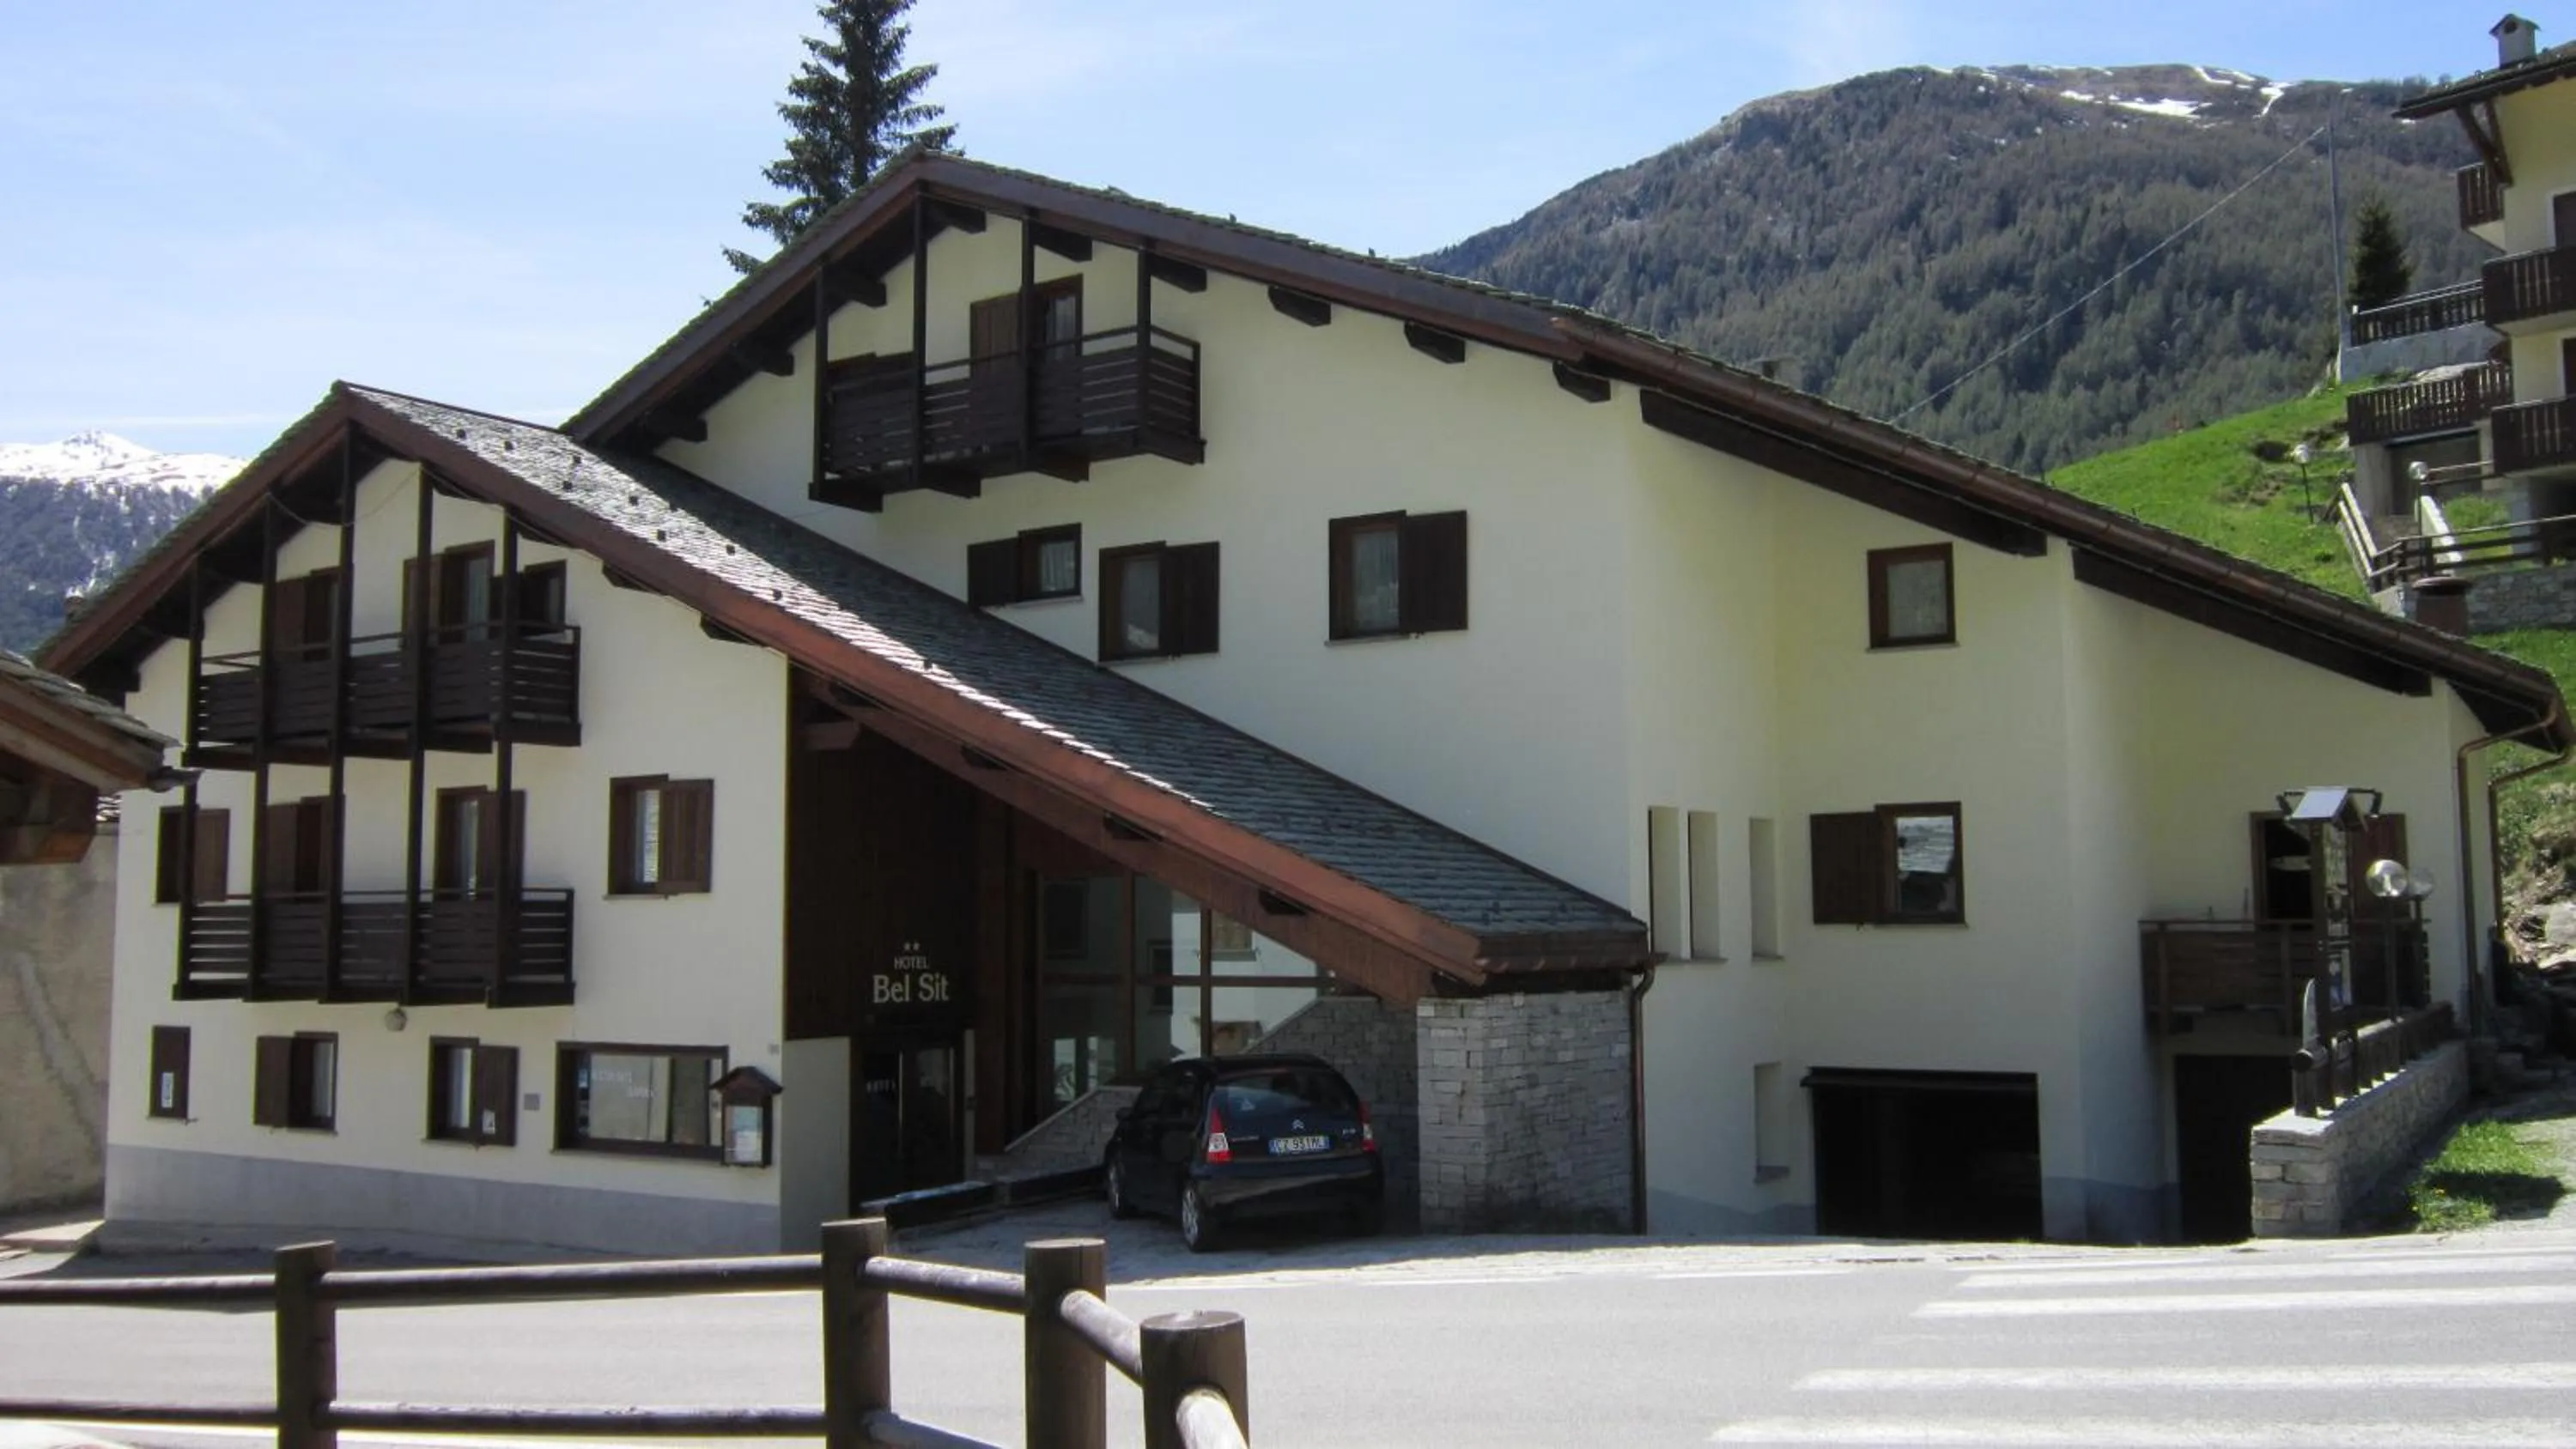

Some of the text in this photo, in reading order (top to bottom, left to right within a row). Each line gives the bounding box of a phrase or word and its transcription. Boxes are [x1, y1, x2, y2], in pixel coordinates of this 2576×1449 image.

[894, 955, 929, 969] HOTEL
[872, 972, 950, 1003] Bel Sit
